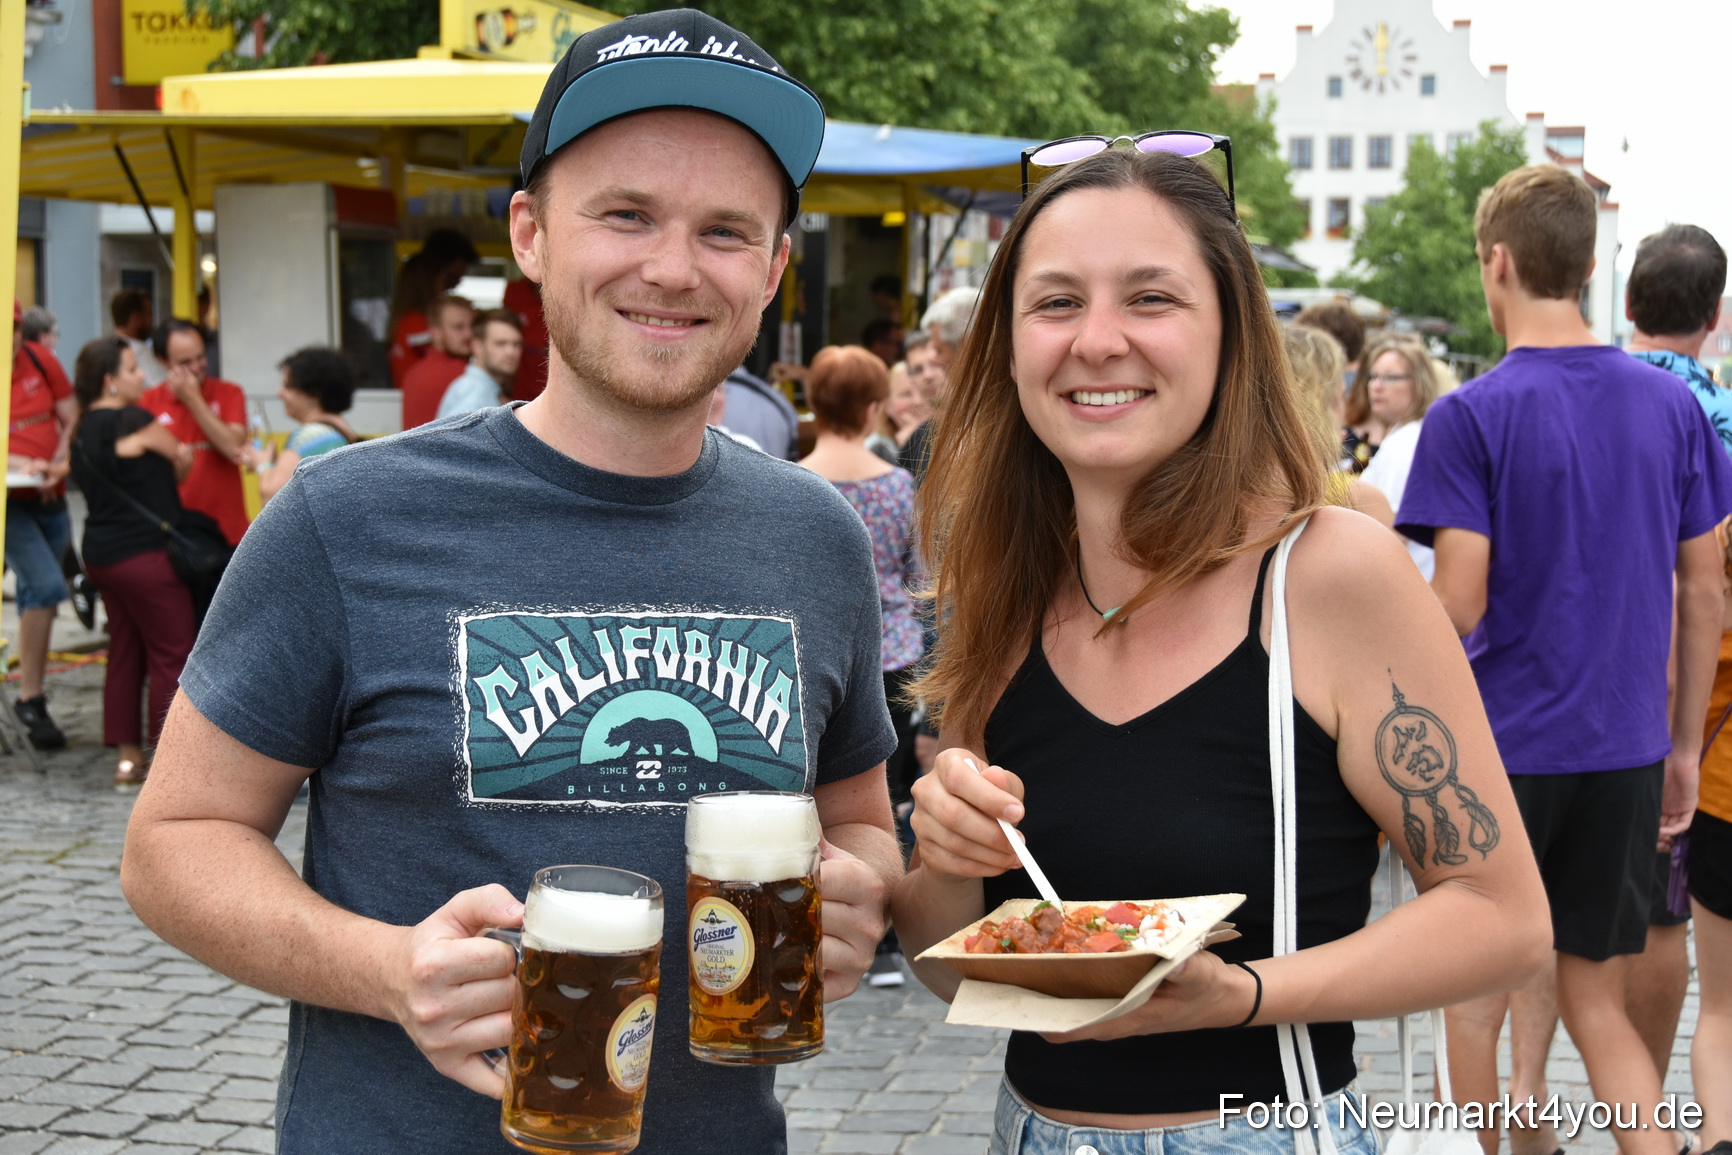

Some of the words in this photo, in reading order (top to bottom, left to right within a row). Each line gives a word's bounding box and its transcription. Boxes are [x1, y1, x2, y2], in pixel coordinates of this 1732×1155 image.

[472, 624, 794, 758] CALIFORNIA
[600, 766, 629, 775] SINCE
[667, 766, 688, 774] 1973
[567, 781, 727, 795] BILLABONG
[693, 925, 738, 952] Glossner
[706, 954, 726, 964] GOLD
